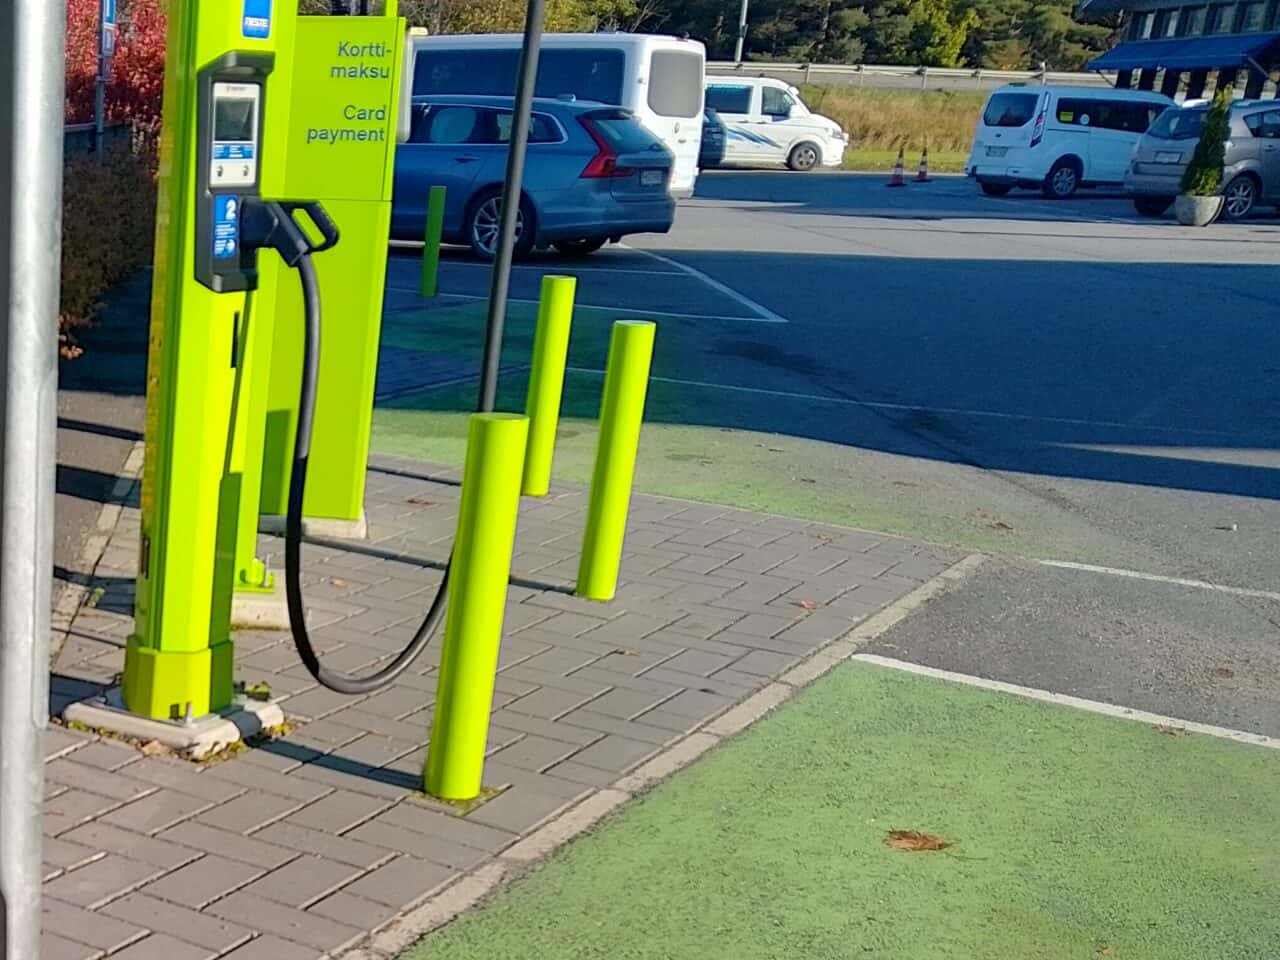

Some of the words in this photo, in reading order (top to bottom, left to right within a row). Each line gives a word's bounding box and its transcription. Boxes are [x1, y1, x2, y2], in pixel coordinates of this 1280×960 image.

[338, 41, 392, 58] Kortti-
[331, 63, 390, 79] maksu
[343, 105, 387, 120] Card
[307, 127, 385, 144] payment
[225, 199, 237, 220] 2
